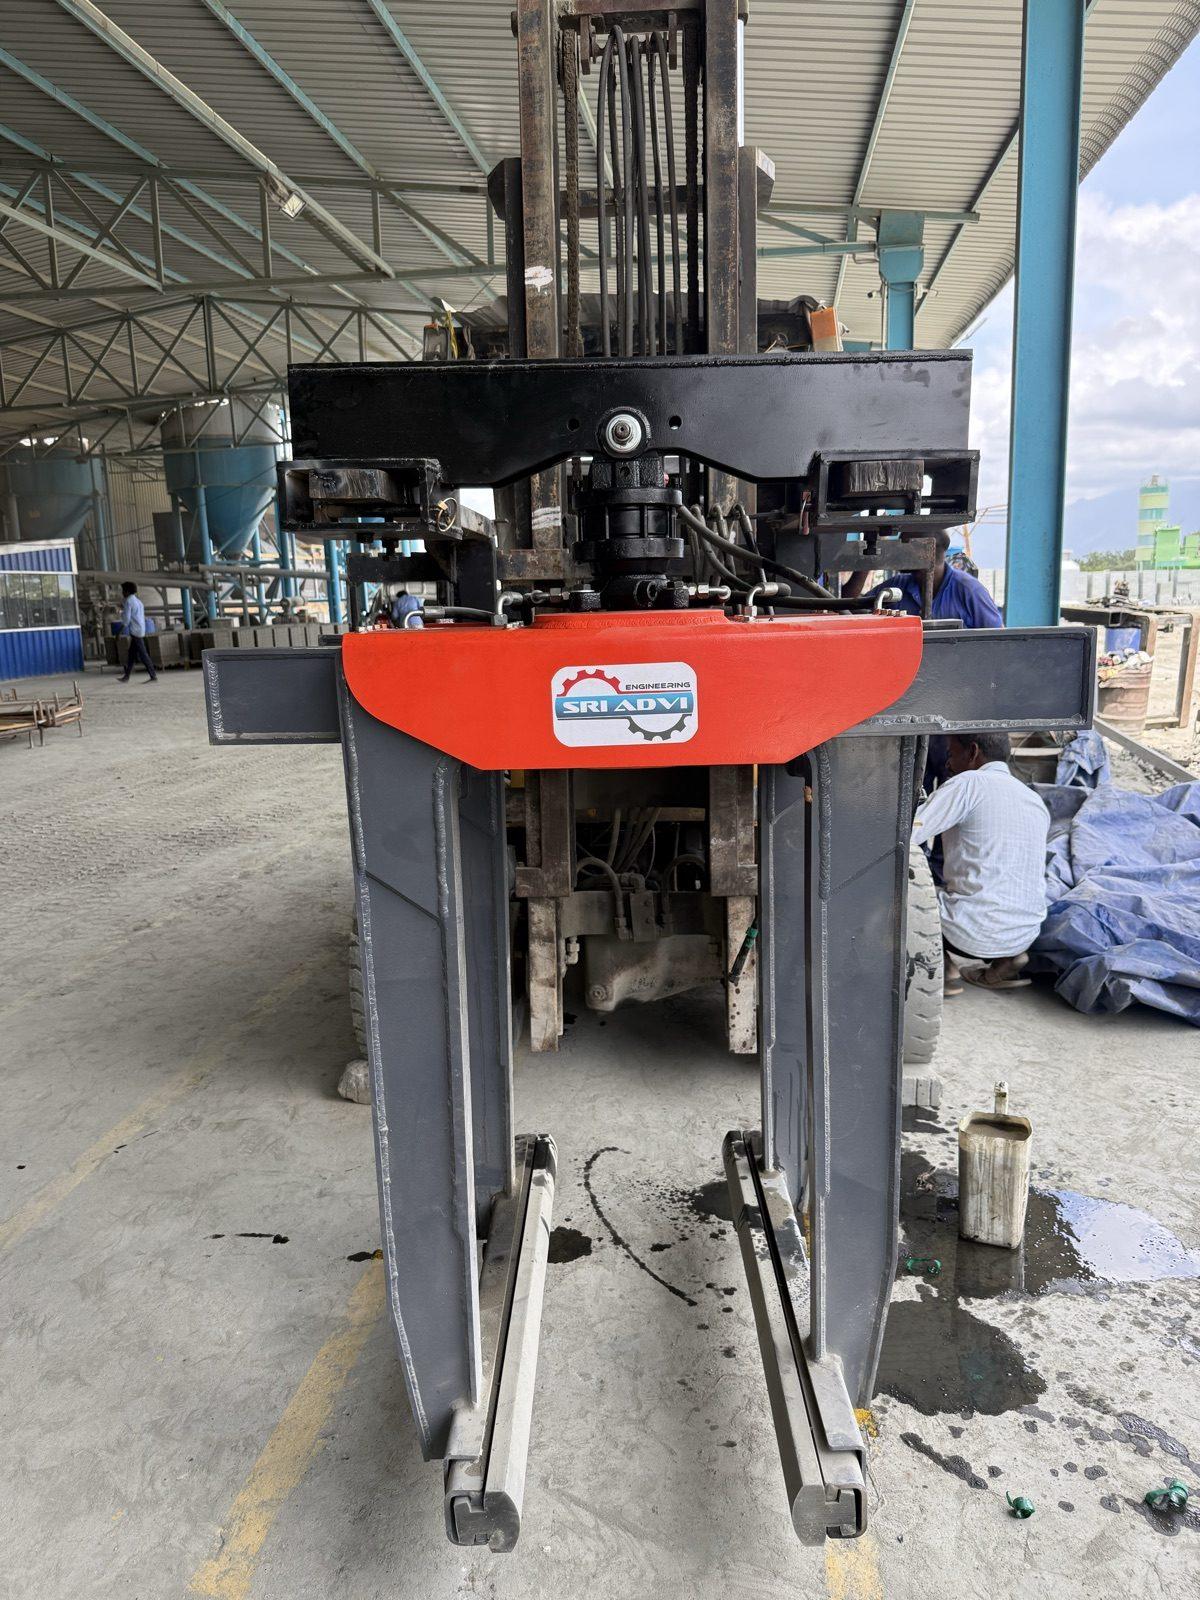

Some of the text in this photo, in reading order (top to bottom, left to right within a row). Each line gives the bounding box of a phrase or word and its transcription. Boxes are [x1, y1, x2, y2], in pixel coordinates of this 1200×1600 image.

[625, 681, 691, 691] ENGINEERING
[562, 696, 688, 714] SRI ADVI
